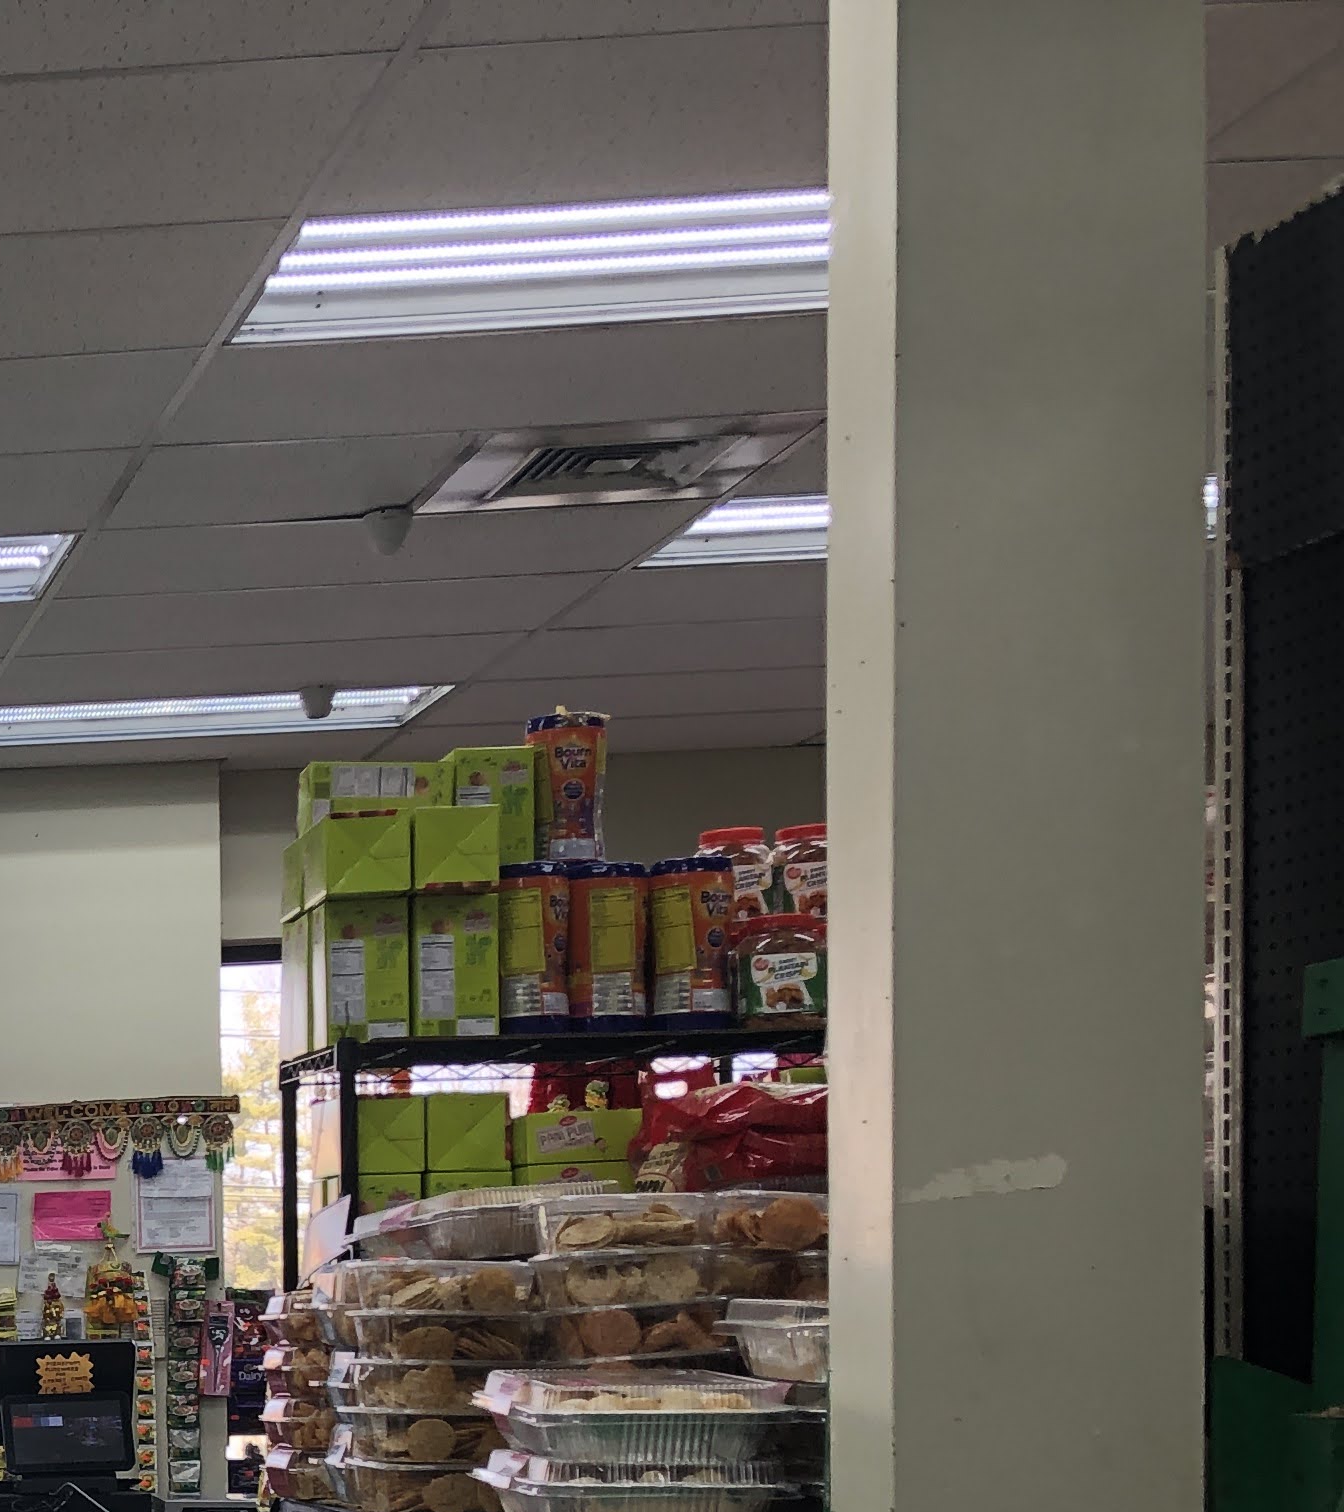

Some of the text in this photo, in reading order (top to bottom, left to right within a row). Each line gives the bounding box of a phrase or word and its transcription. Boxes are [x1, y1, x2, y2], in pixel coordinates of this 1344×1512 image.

[554, 745, 592, 759] Bourn
[560, 756, 587, 770] Vita
[238, 1370, 263, 1382] Dairy
